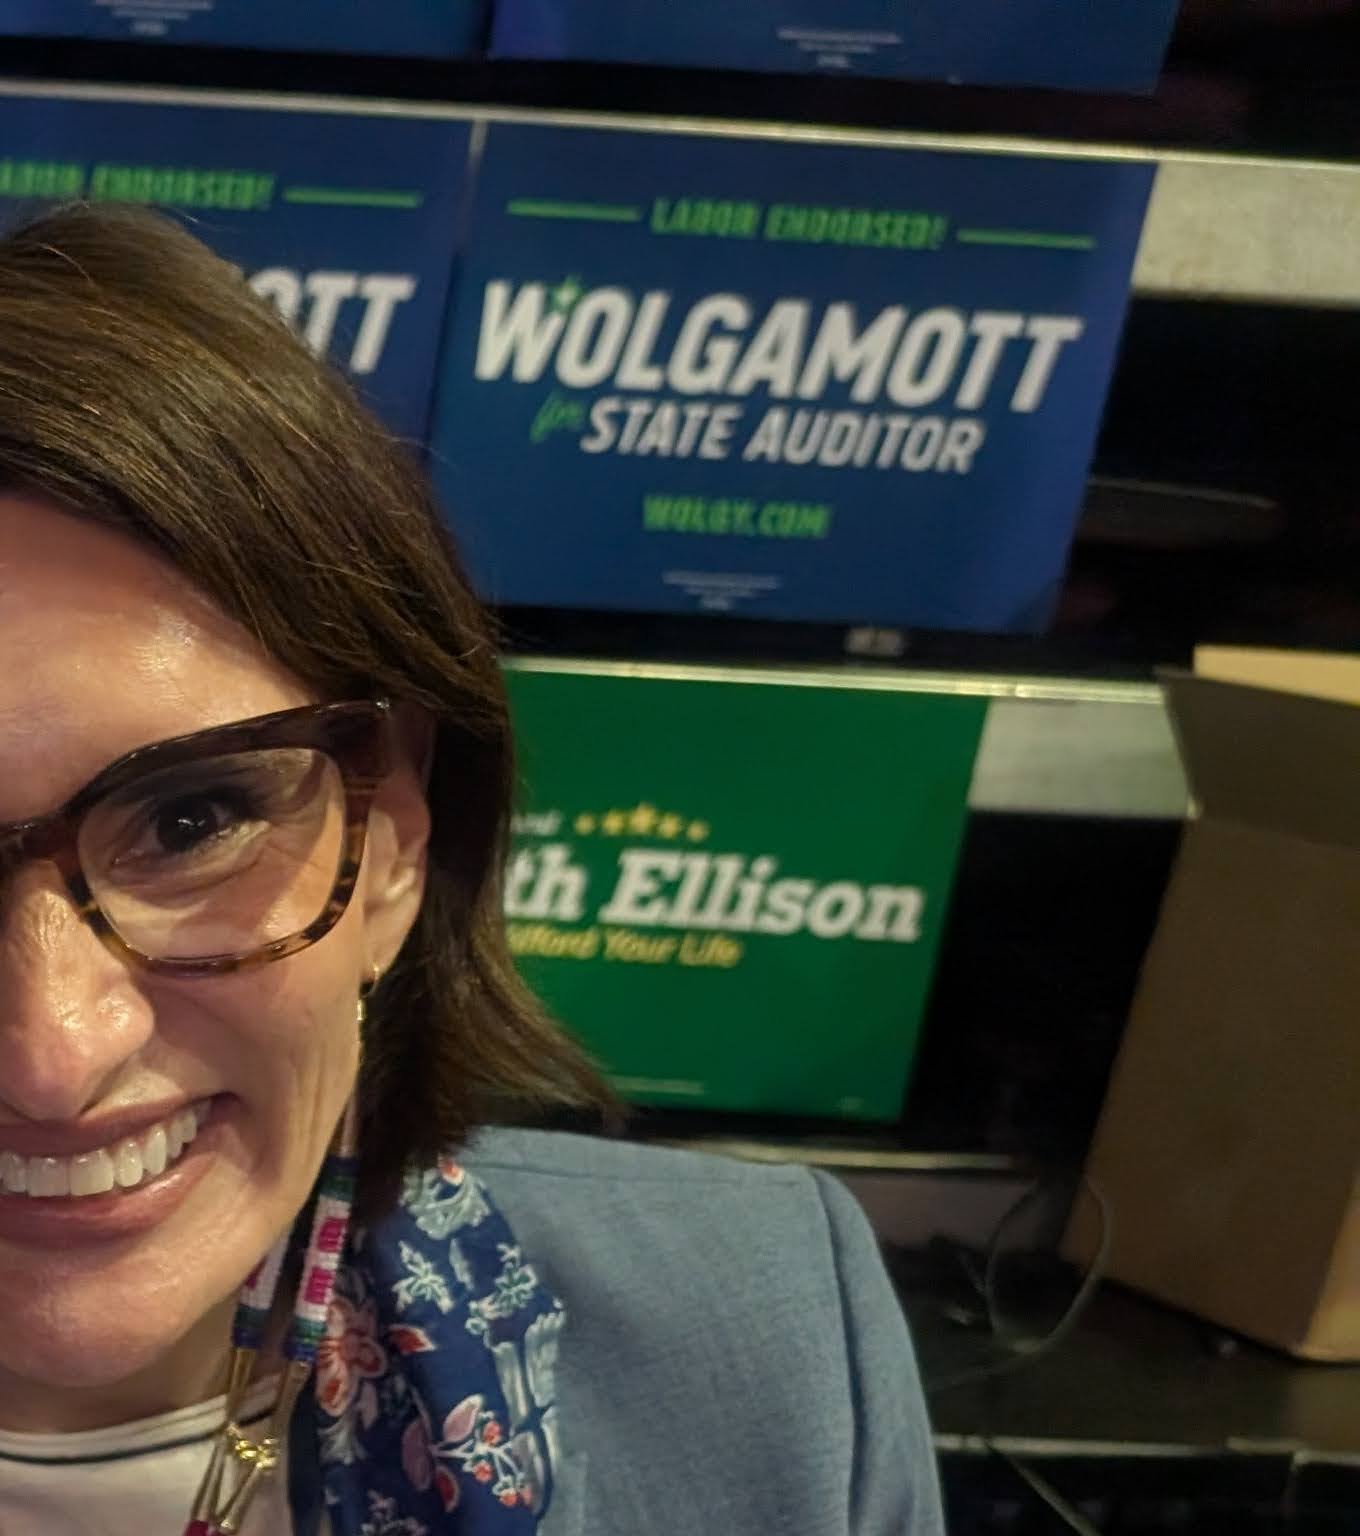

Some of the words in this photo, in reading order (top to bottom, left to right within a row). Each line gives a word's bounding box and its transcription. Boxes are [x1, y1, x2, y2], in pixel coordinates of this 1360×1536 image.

[650, 197, 757, 240] LABOR
[765, 202, 950, 252] ENDORSED!
[473, 276, 1086, 415] WOLGAMOTT
[580, 396, 747, 462] STATE
[742, 408, 986, 475] AUDITOR
[598, 846, 926, 945] Ellison
[604, 928, 677, 965] Your
[678, 934, 743, 969] Life
